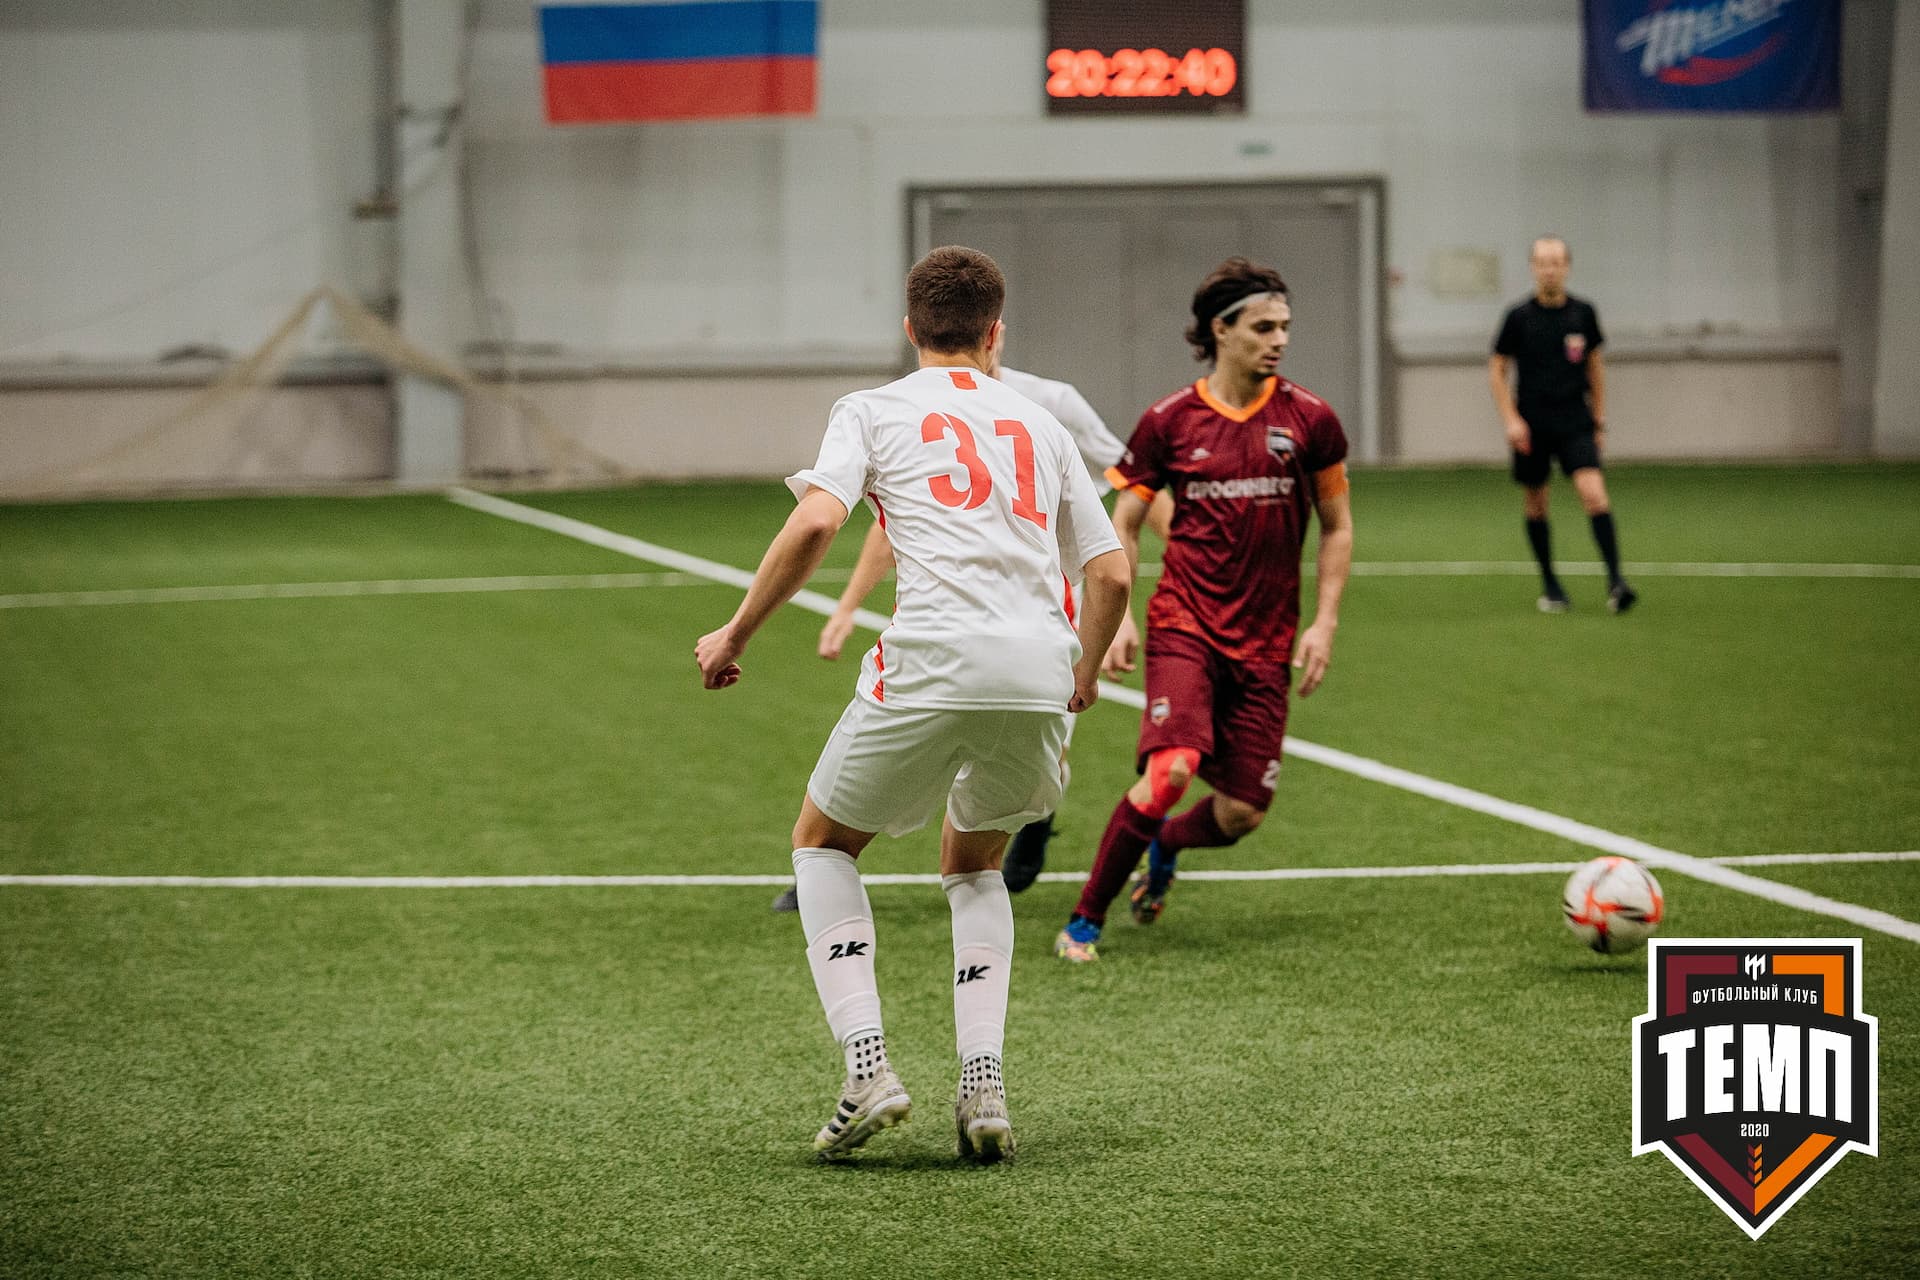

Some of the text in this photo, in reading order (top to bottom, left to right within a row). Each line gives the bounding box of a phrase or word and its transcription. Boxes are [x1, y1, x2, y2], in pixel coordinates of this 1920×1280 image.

[1046, 48, 1237, 97] 20:22:40
[920, 411, 1048, 532] 31
[827, 941, 869, 961] 2K
[956, 965, 991, 986] 2K
